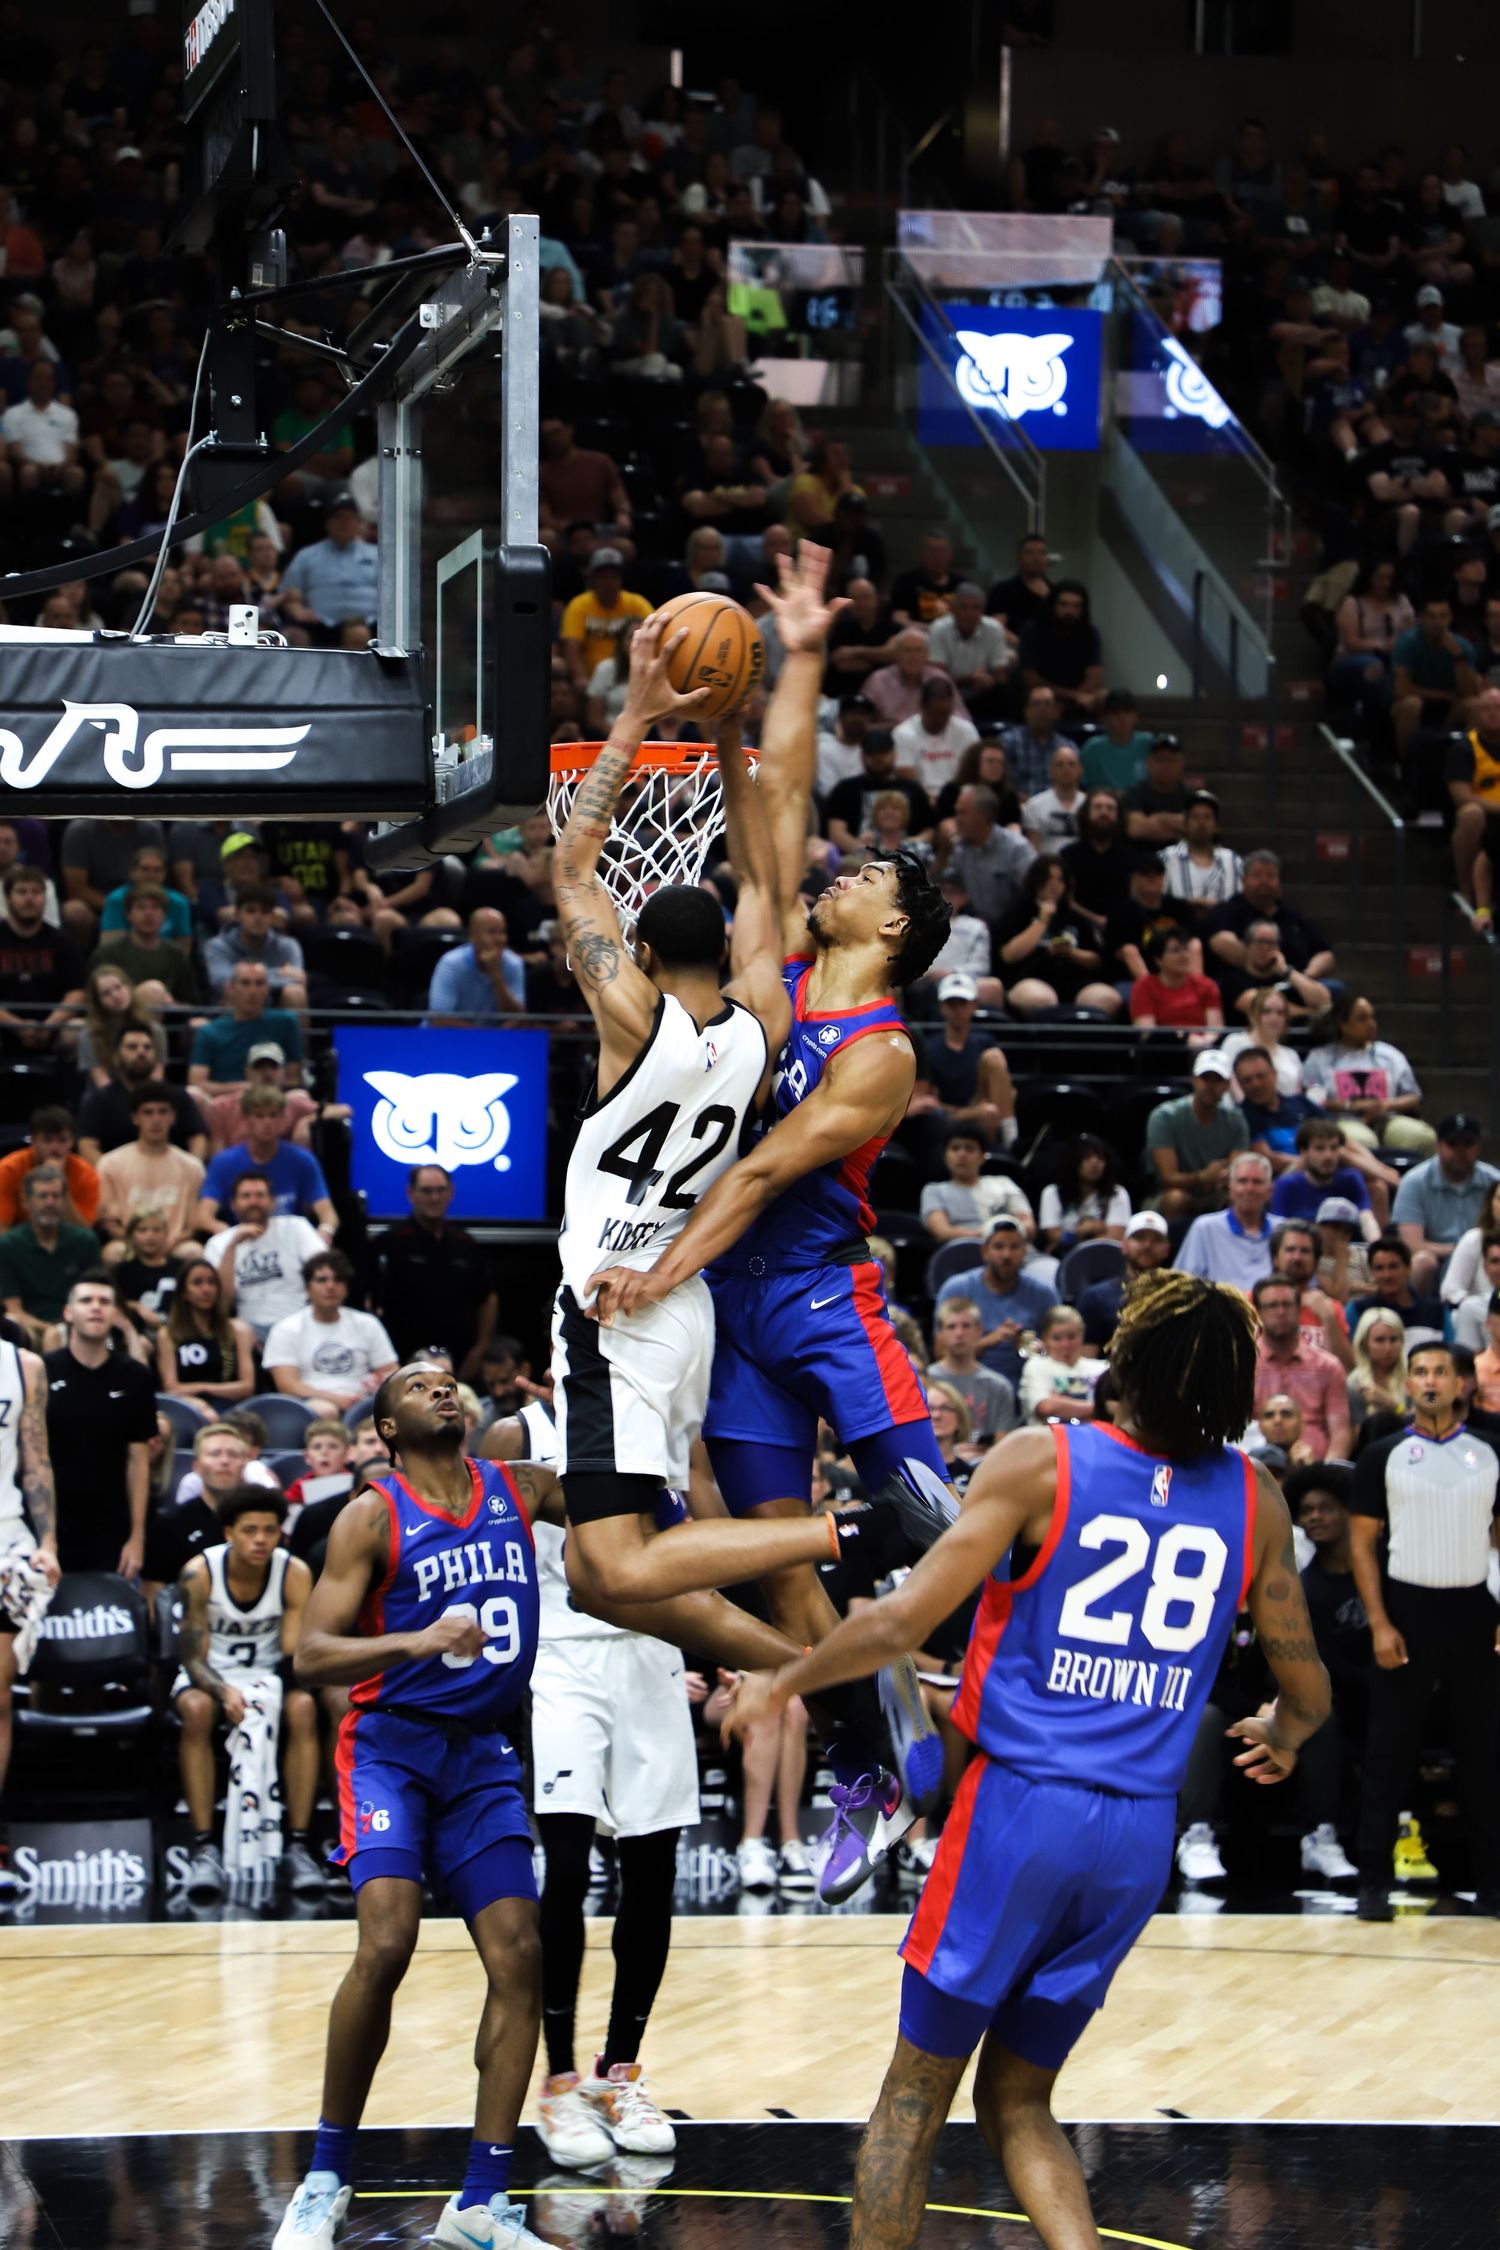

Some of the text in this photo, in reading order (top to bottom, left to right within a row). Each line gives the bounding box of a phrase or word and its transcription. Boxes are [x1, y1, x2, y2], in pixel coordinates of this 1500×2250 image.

[801, 1034, 828, 1059] crypto.com
[597, 1101, 737, 1210] 42
[178, 1342, 208, 1367] 10
[487, 1515, 519, 1526] crypto.com
[413, 1541, 528, 1603] PHILA
[1058, 1513, 1228, 1653] 28
[1047, 1648, 1193, 1712] BROWN III
[14, 1846, 146, 1889] Smith's
